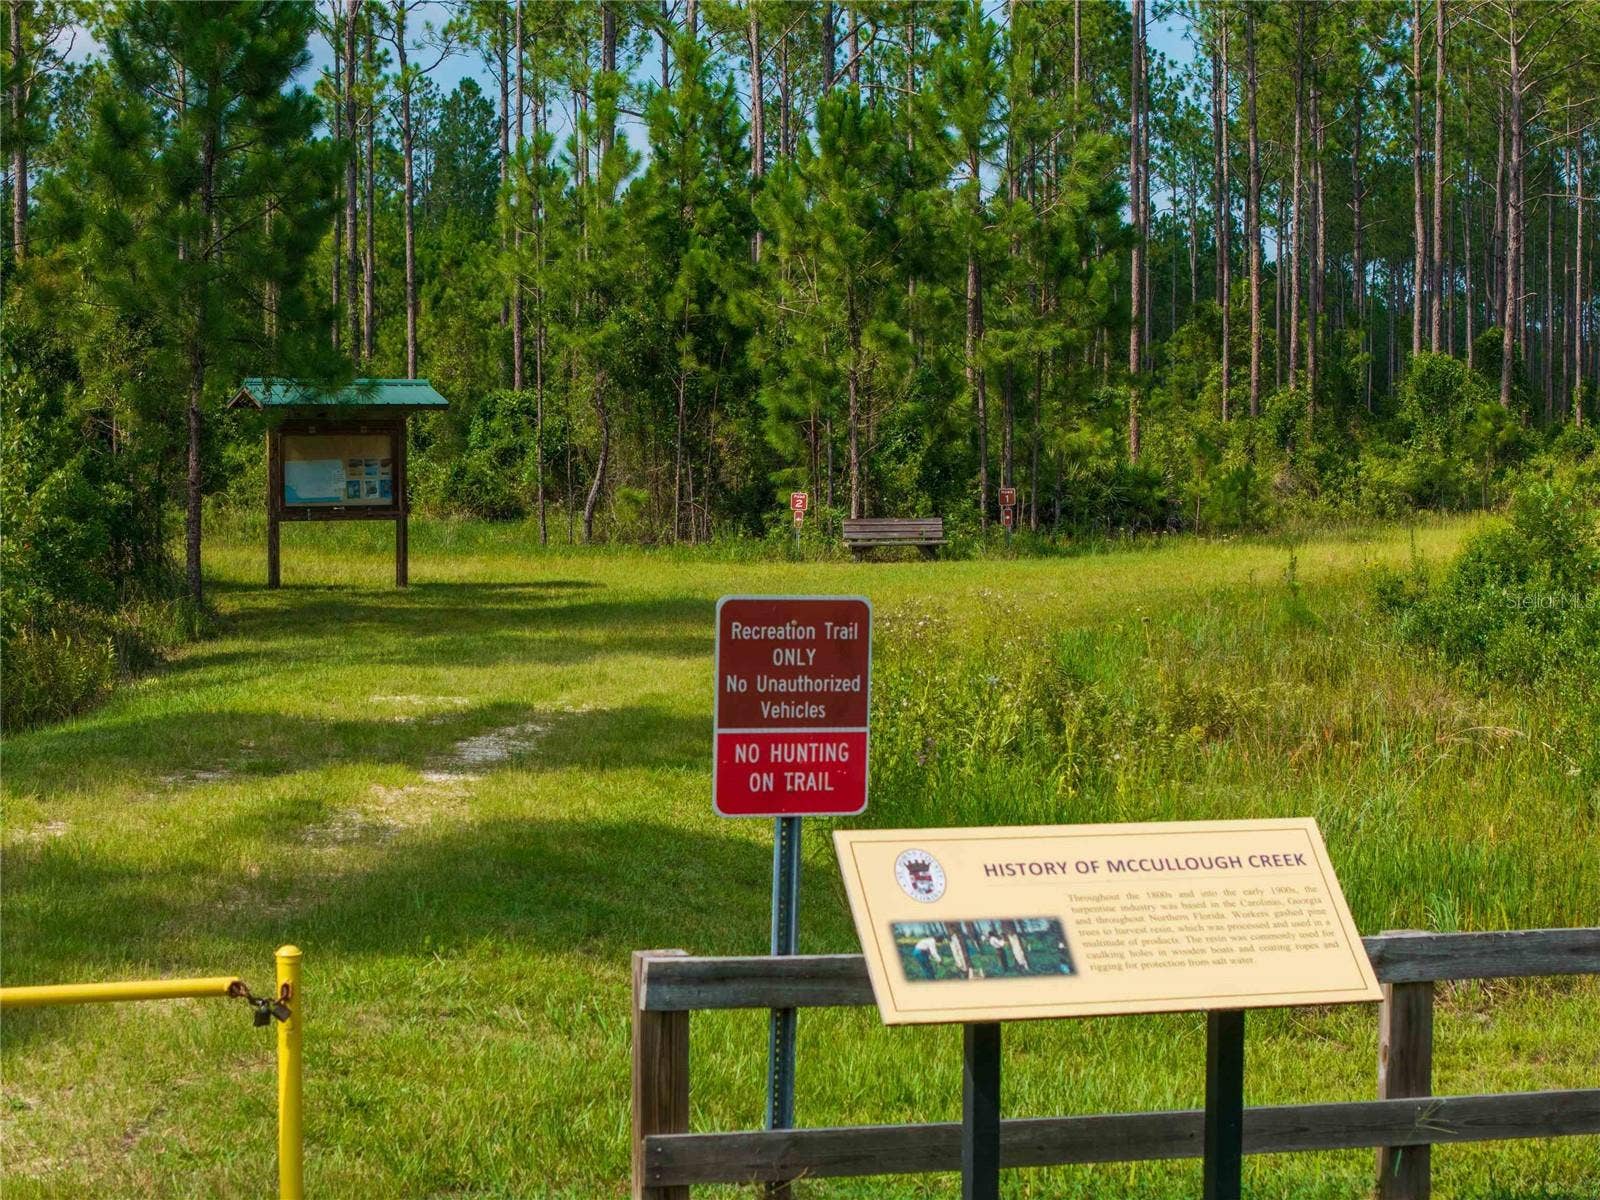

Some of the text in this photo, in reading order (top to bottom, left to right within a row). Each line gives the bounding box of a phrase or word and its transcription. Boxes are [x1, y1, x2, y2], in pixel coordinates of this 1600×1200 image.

[795, 499, 803, 508] 2
[731, 622, 858, 640] Recreation Trail
[773, 648, 816, 666] ONLY
[726, 675, 861, 693] No Unauthorized
[761, 701, 826, 719] Vehicles
[735, 742, 849, 764] NO HUNTING
[750, 772, 834, 792] ON TRAIL
[983, 853, 1307, 877] HISTORY OF MCCULLOUGH CREEK
[1068, 894, 1120, 902] Throughout
[1179, 890, 1195, 898] and
[1200, 889, 1217, 897] into
[1223, 888, 1237, 896] the
[1243, 888, 1264, 897] early
[1071, 905, 1116, 914] turpentine
[1120, 904, 1156, 912] industry
[1181, 901, 1207, 909] based
[1223, 900, 1236, 908] the
[1287, 898, 1322, 906] Georgia
[1095, 916, 1144, 925] throughout
[1148, 914, 1189, 922] Northern
[1232, 911, 1269, 919] Workers
[1274, 909, 1304, 919] gashed
[1307, 909, 1327, 917] pine
[1078, 929, 1100, 937] trees
[1115, 927, 1147, 935] harvest
[1178, 924, 1204, 932] which
[1227, 922, 1270, 932] processed
[1291, 919, 1311, 928] used
[1128, 938, 1139, 946] of
[1186, 935, 1202, 943] The
[1250, 932, 1296, 941] commonly
[1299, 930, 1319, 939] used
[1322, 929, 1335, 937] for
[1086, 941, 1340, 960] caulking holes in wooden boats and coating ropes and
[1090, 963, 1122, 973] rigging
[1125, 961, 1138, 970] for
[1140, 959, 1186, 970] protection
[1188, 958, 1209, 967] from
[1212, 957, 1227, 965] salt
